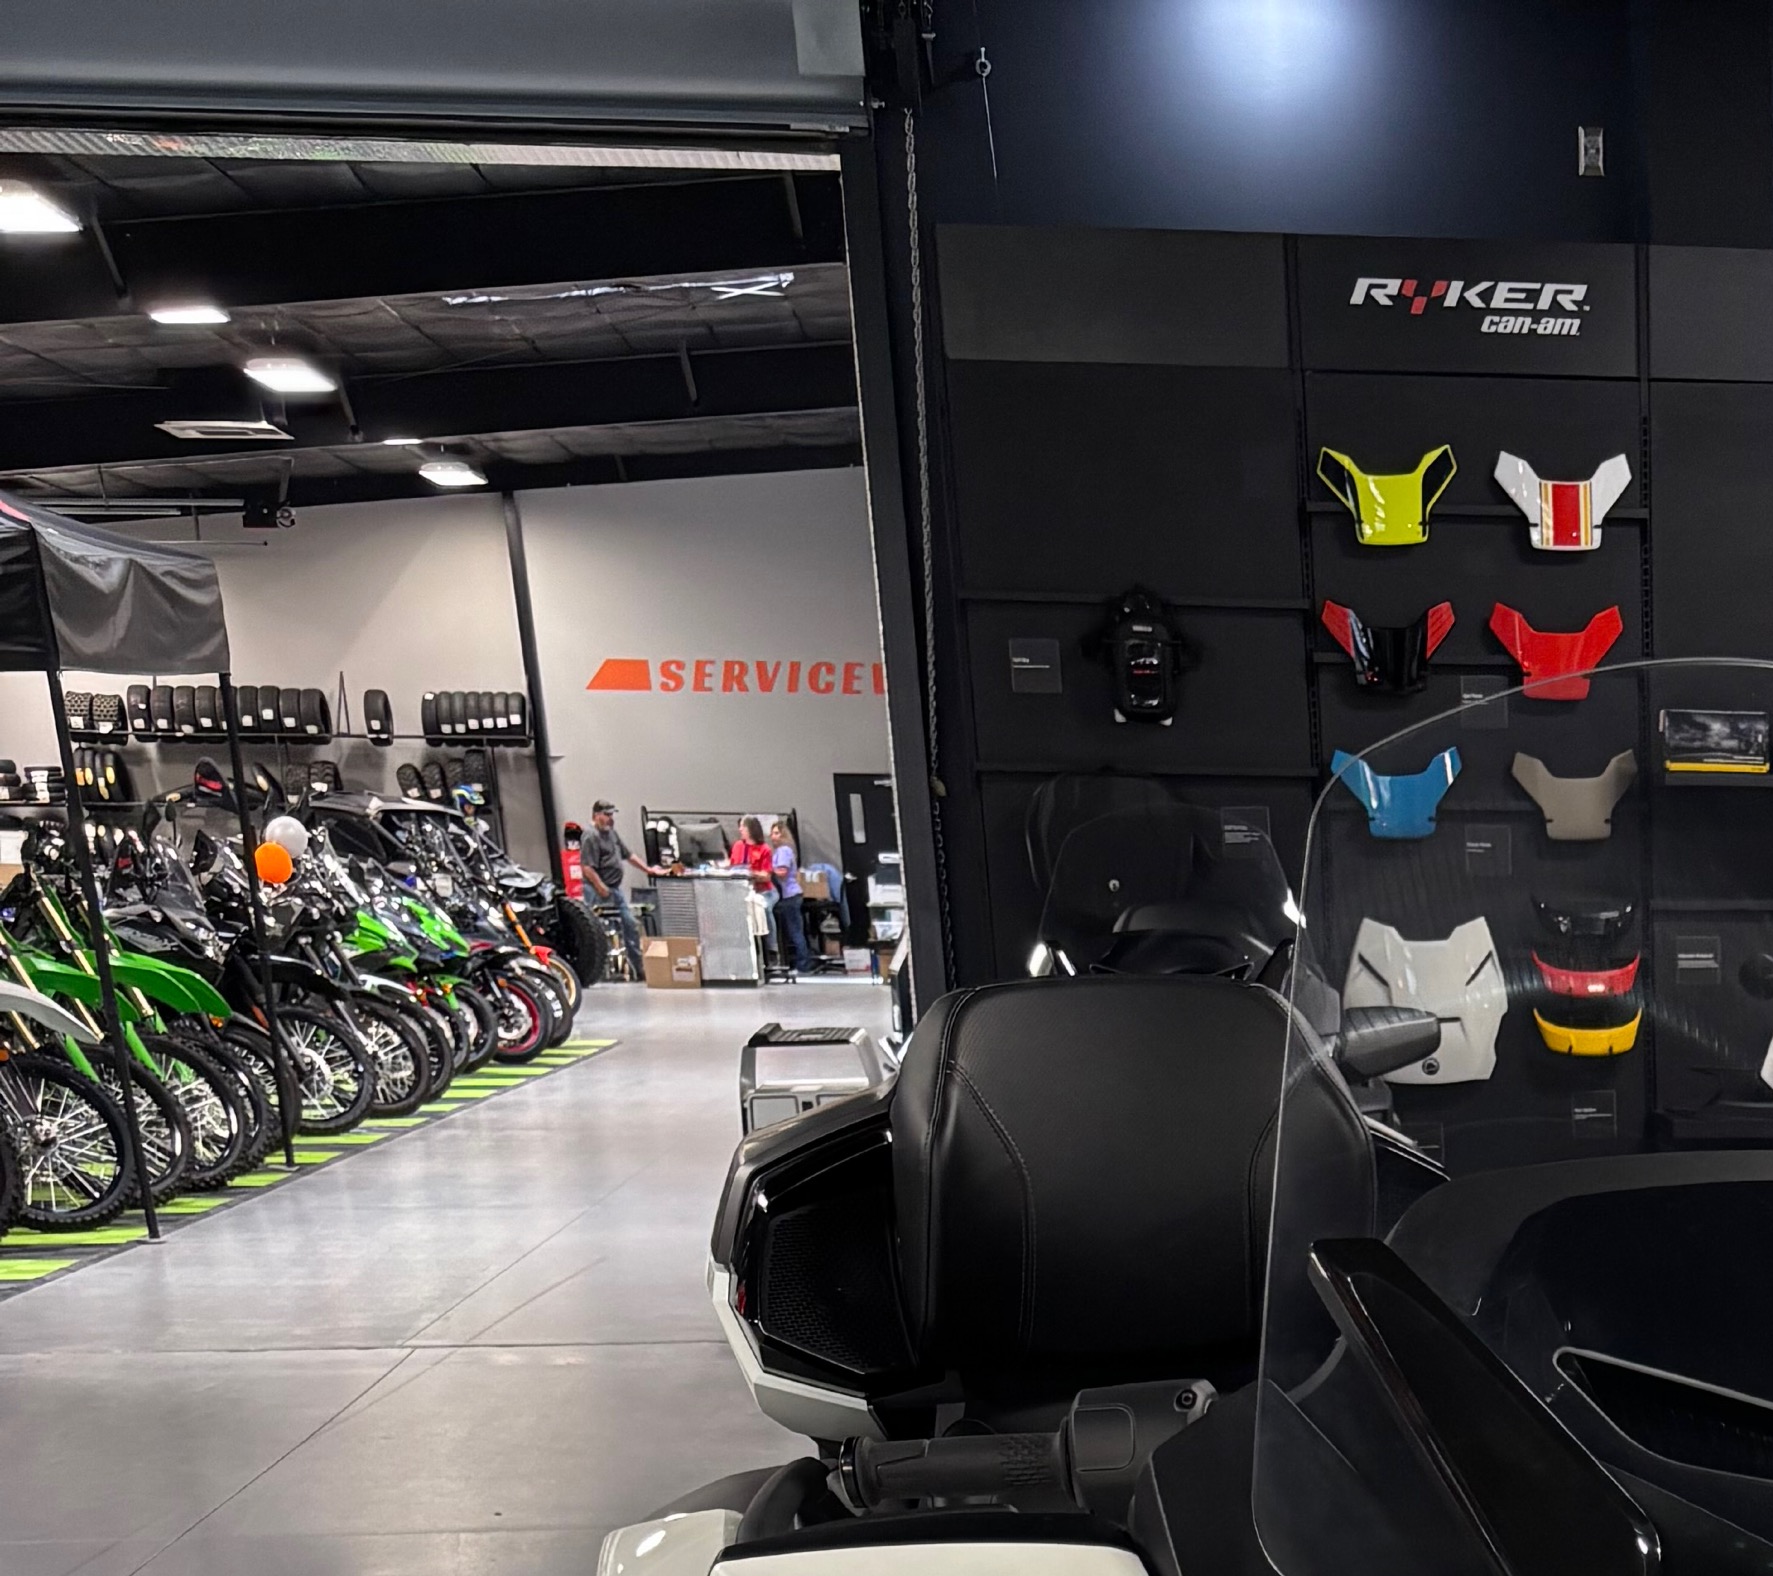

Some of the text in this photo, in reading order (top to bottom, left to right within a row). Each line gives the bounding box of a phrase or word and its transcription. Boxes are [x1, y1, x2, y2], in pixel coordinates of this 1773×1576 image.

[1350, 278, 1587, 314] RYKER
[1481, 315, 1580, 336] can-am
[660, 660, 864, 694] SERVICE
